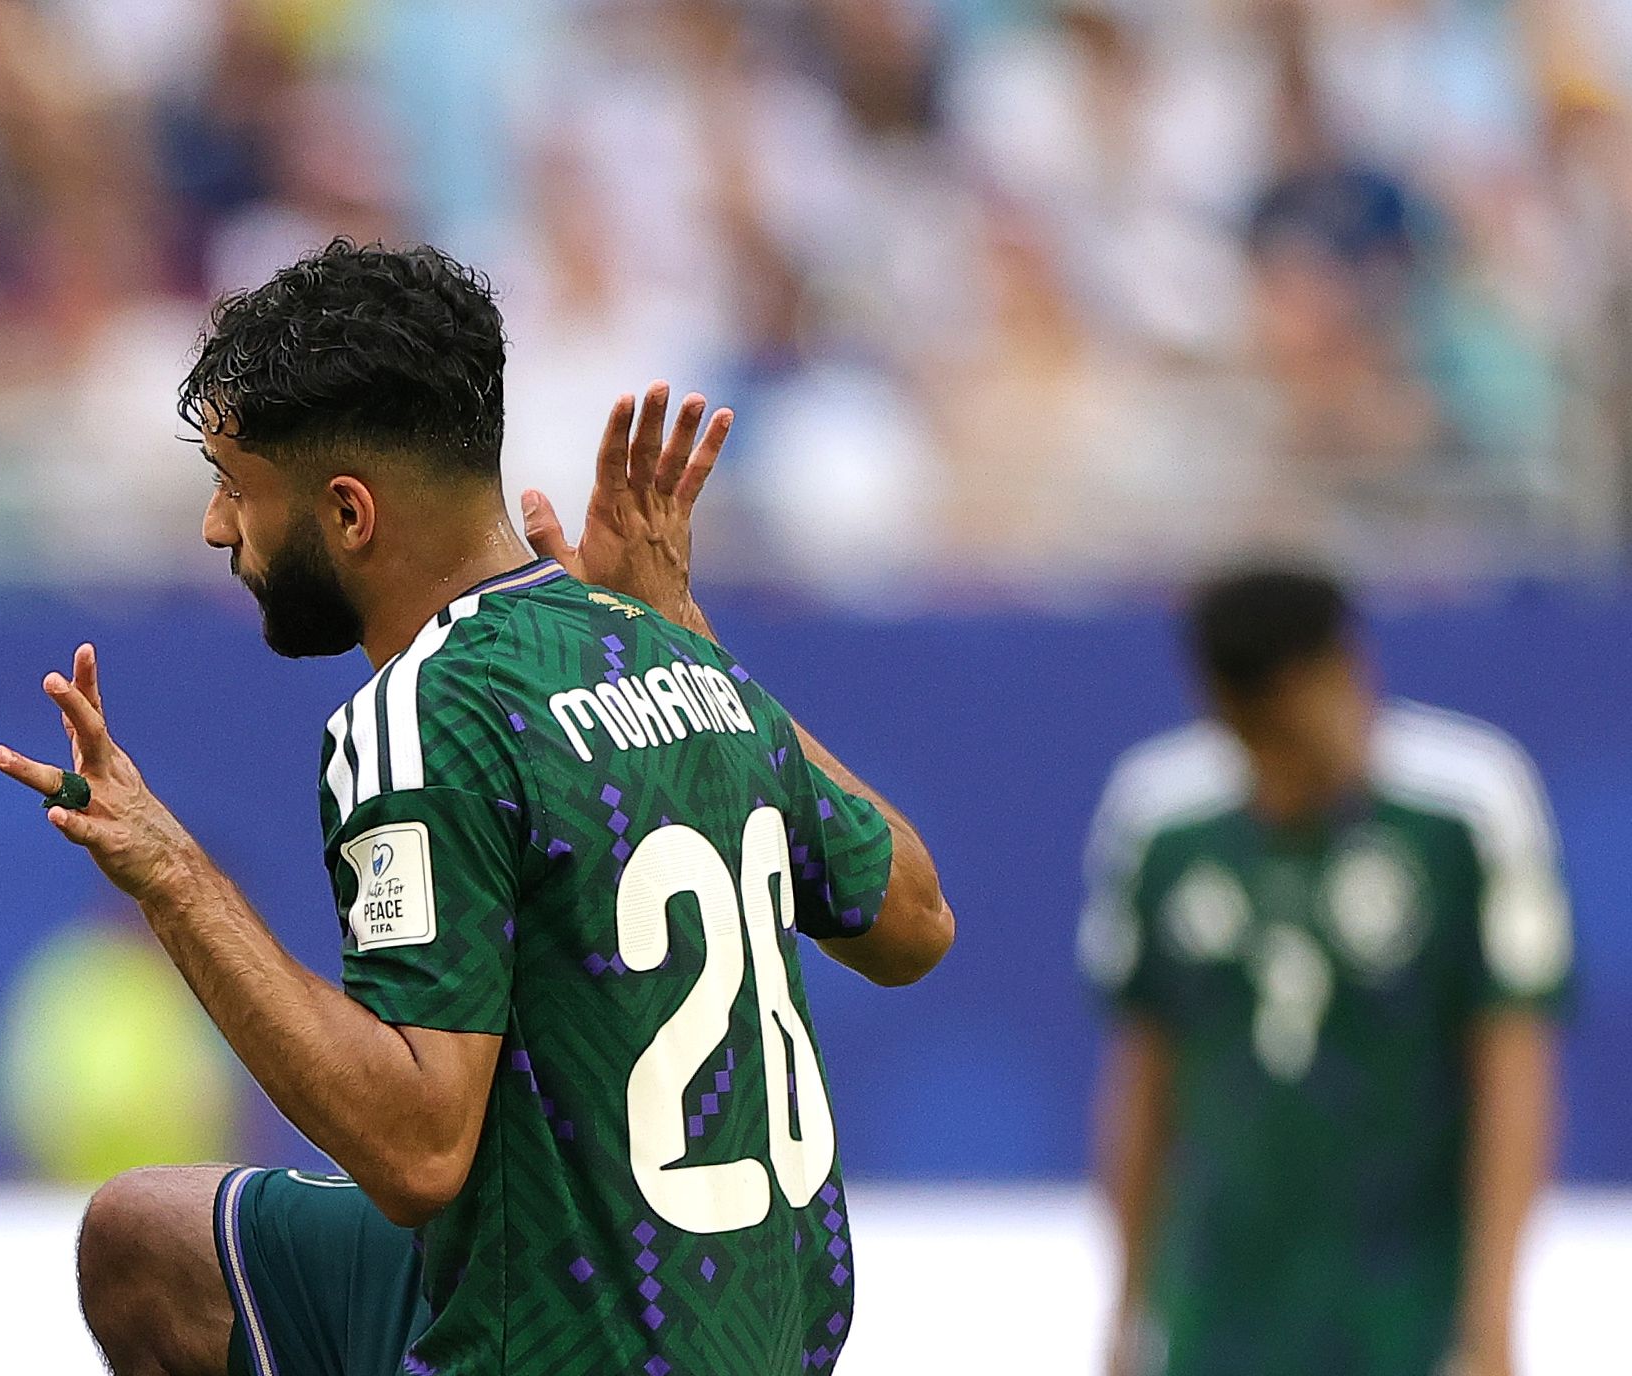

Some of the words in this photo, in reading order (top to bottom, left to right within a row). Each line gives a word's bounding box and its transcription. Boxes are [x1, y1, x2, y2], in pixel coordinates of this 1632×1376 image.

[364, 899, 404, 922] PEACE
[371, 923, 393, 934] FIFA
[616, 806, 835, 1234] 26
